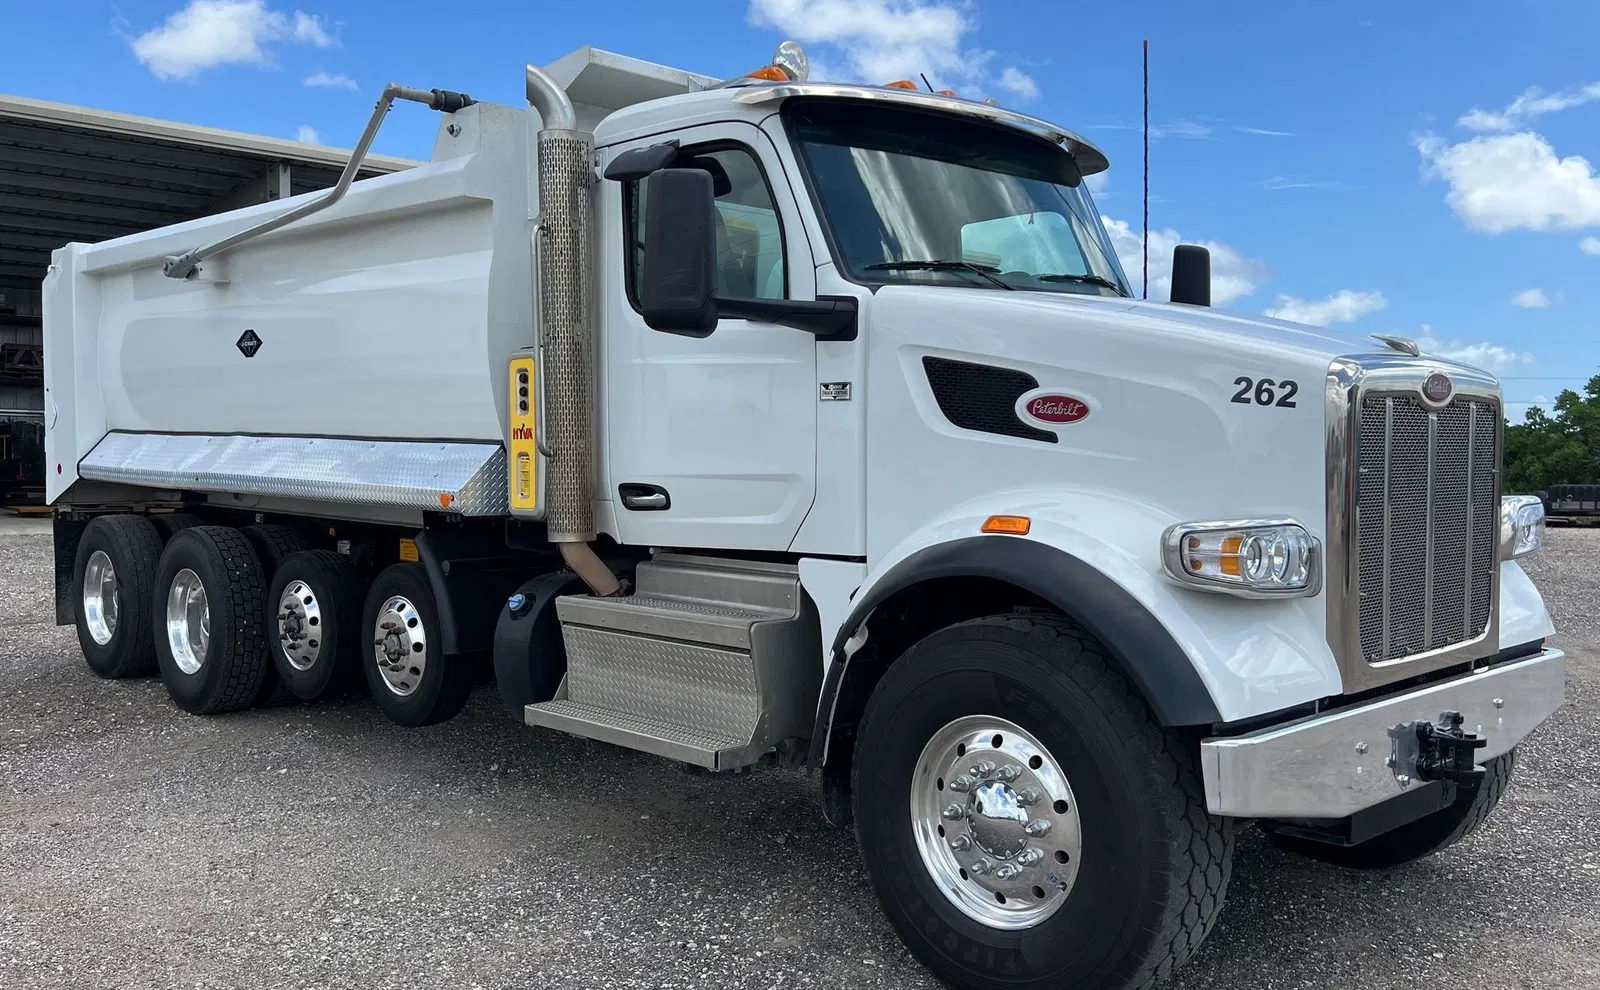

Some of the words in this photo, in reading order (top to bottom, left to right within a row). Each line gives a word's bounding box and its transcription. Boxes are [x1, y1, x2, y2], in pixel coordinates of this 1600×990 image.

[1230, 376, 1298, 408] 262
[1032, 399, 1083, 416] Peterbilt
[512, 423, 534, 440] HYVA
